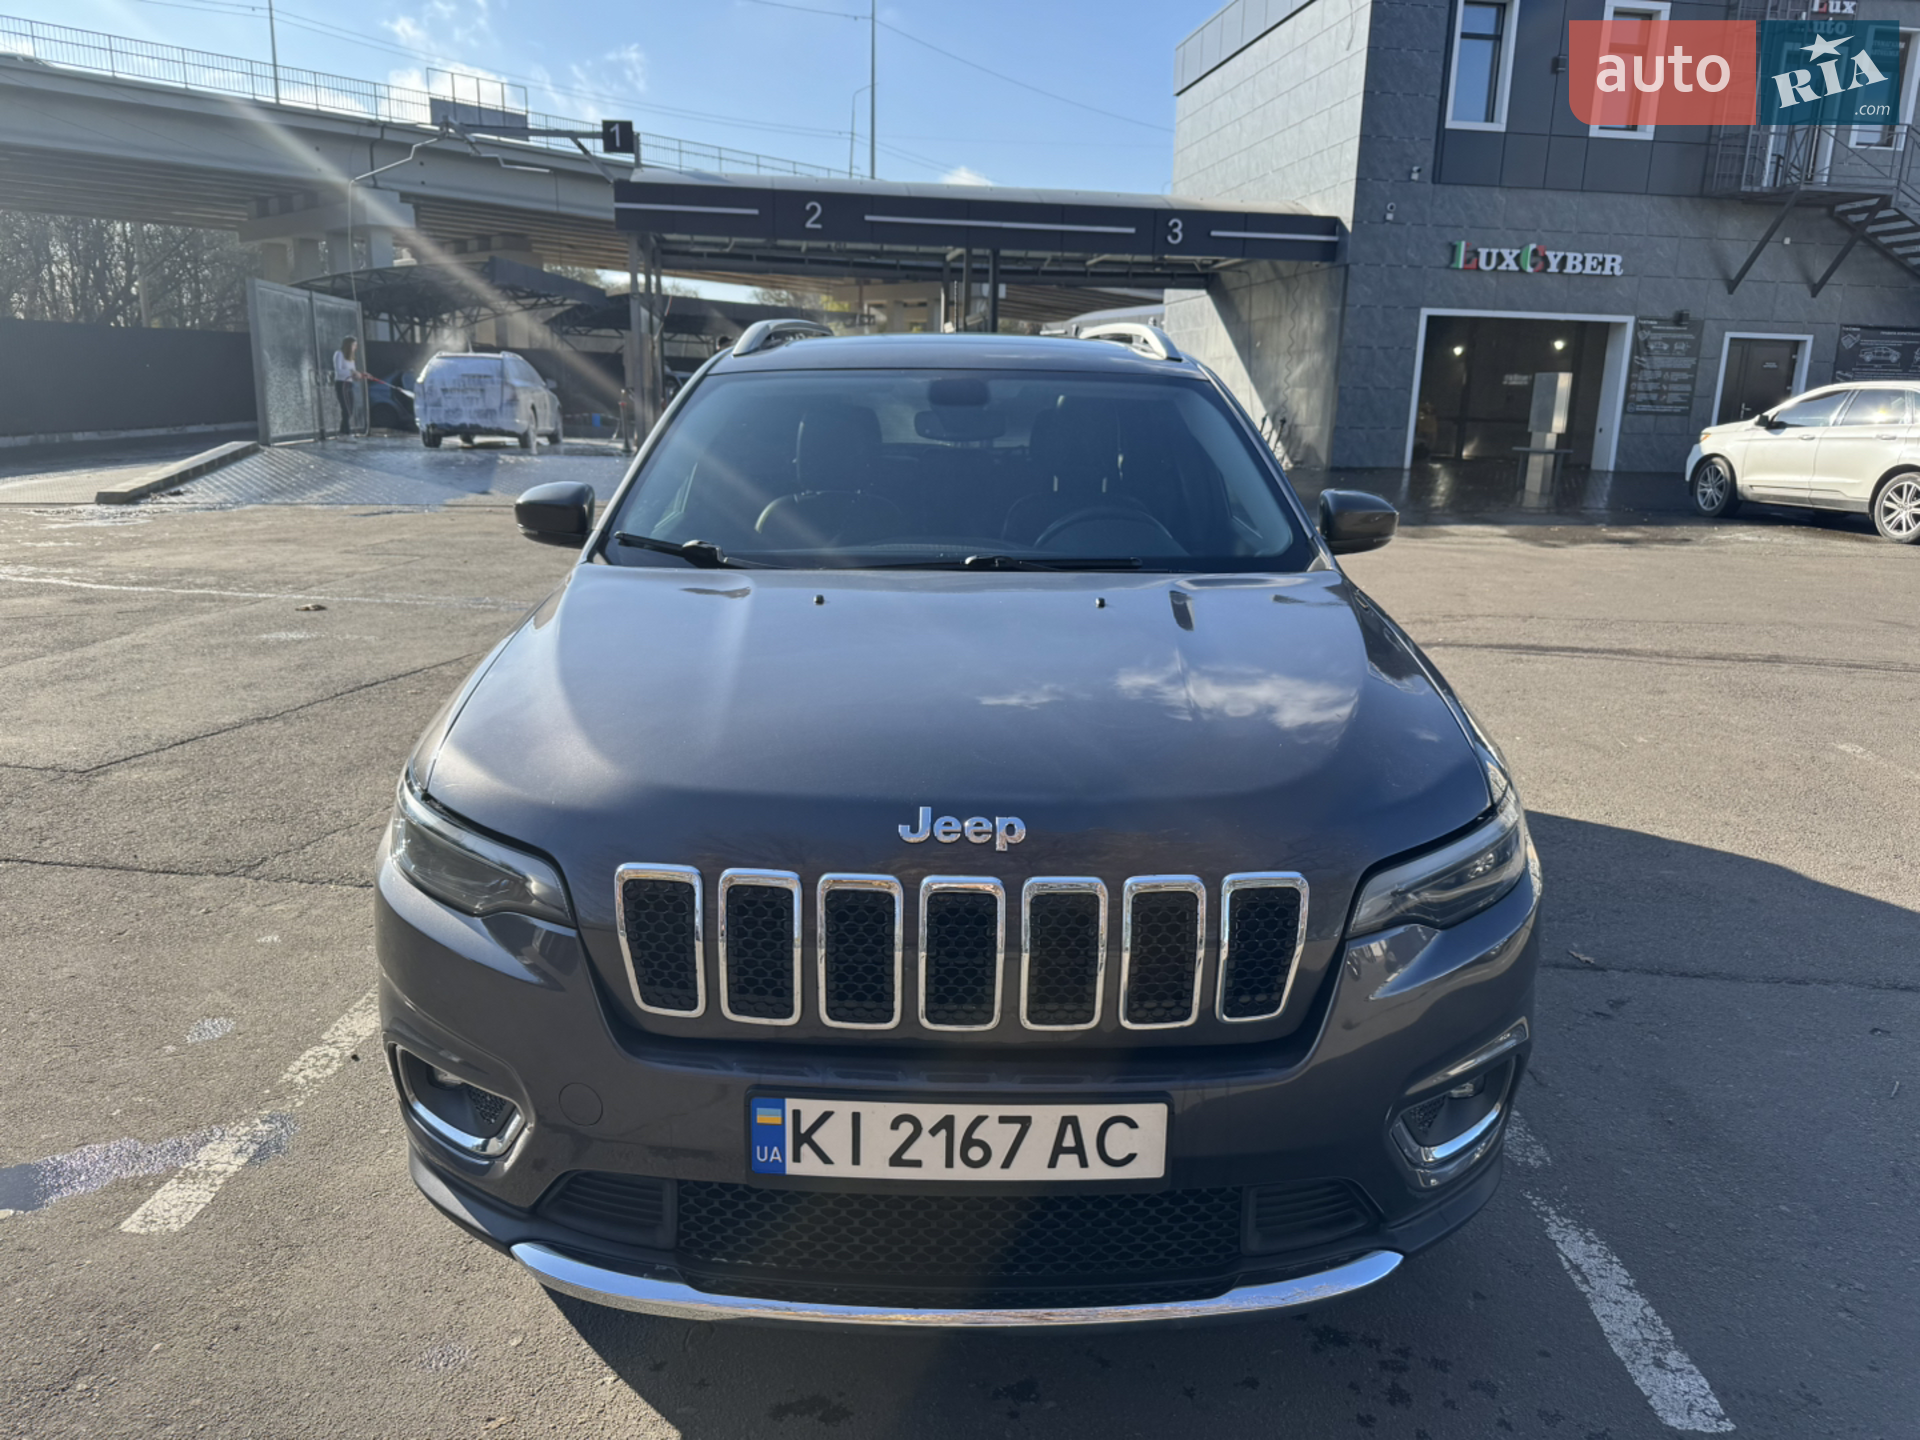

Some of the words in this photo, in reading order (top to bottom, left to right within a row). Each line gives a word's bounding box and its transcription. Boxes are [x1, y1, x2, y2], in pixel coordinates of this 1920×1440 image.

[609, 122, 620, 148] 1
[805, 201, 822, 229] 2
[1166, 218, 1183, 245] 3
[898, 806, 1027, 852] Jeep
[791, 1108, 861, 1166] KI
[888, 1113, 1033, 1170] 2167
[1046, 1114, 1140, 1169] AC
[756, 1145, 783, 1163] UA
